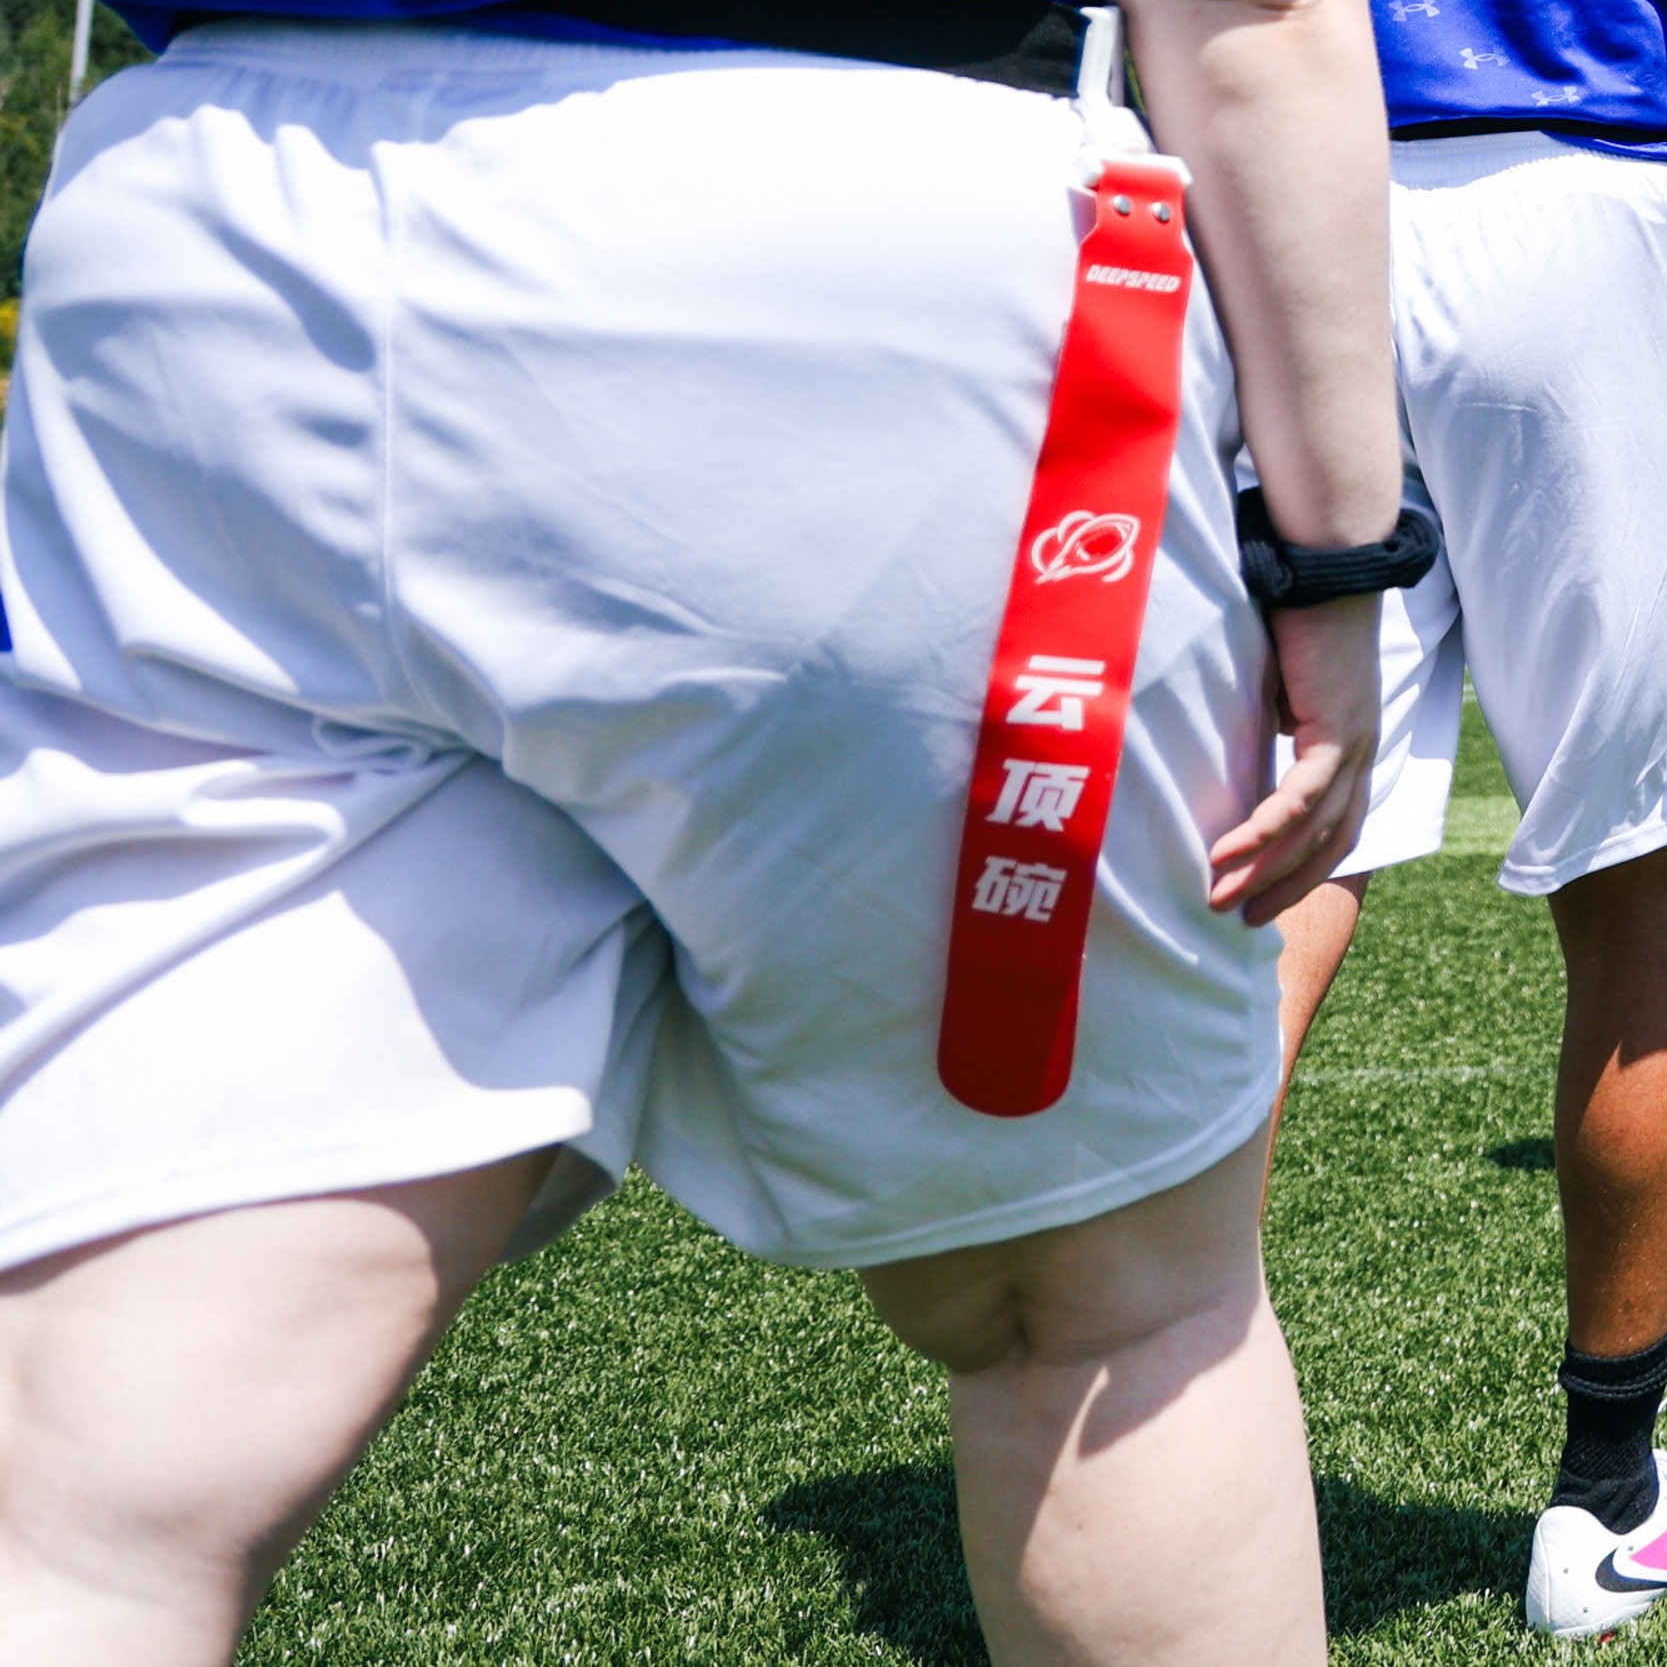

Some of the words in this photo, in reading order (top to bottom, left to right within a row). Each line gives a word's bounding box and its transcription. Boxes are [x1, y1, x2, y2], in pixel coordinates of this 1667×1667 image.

[1085, 264, 1181, 293] DEEPSPEED
[971, 654, 1106, 924] 云顶碗
